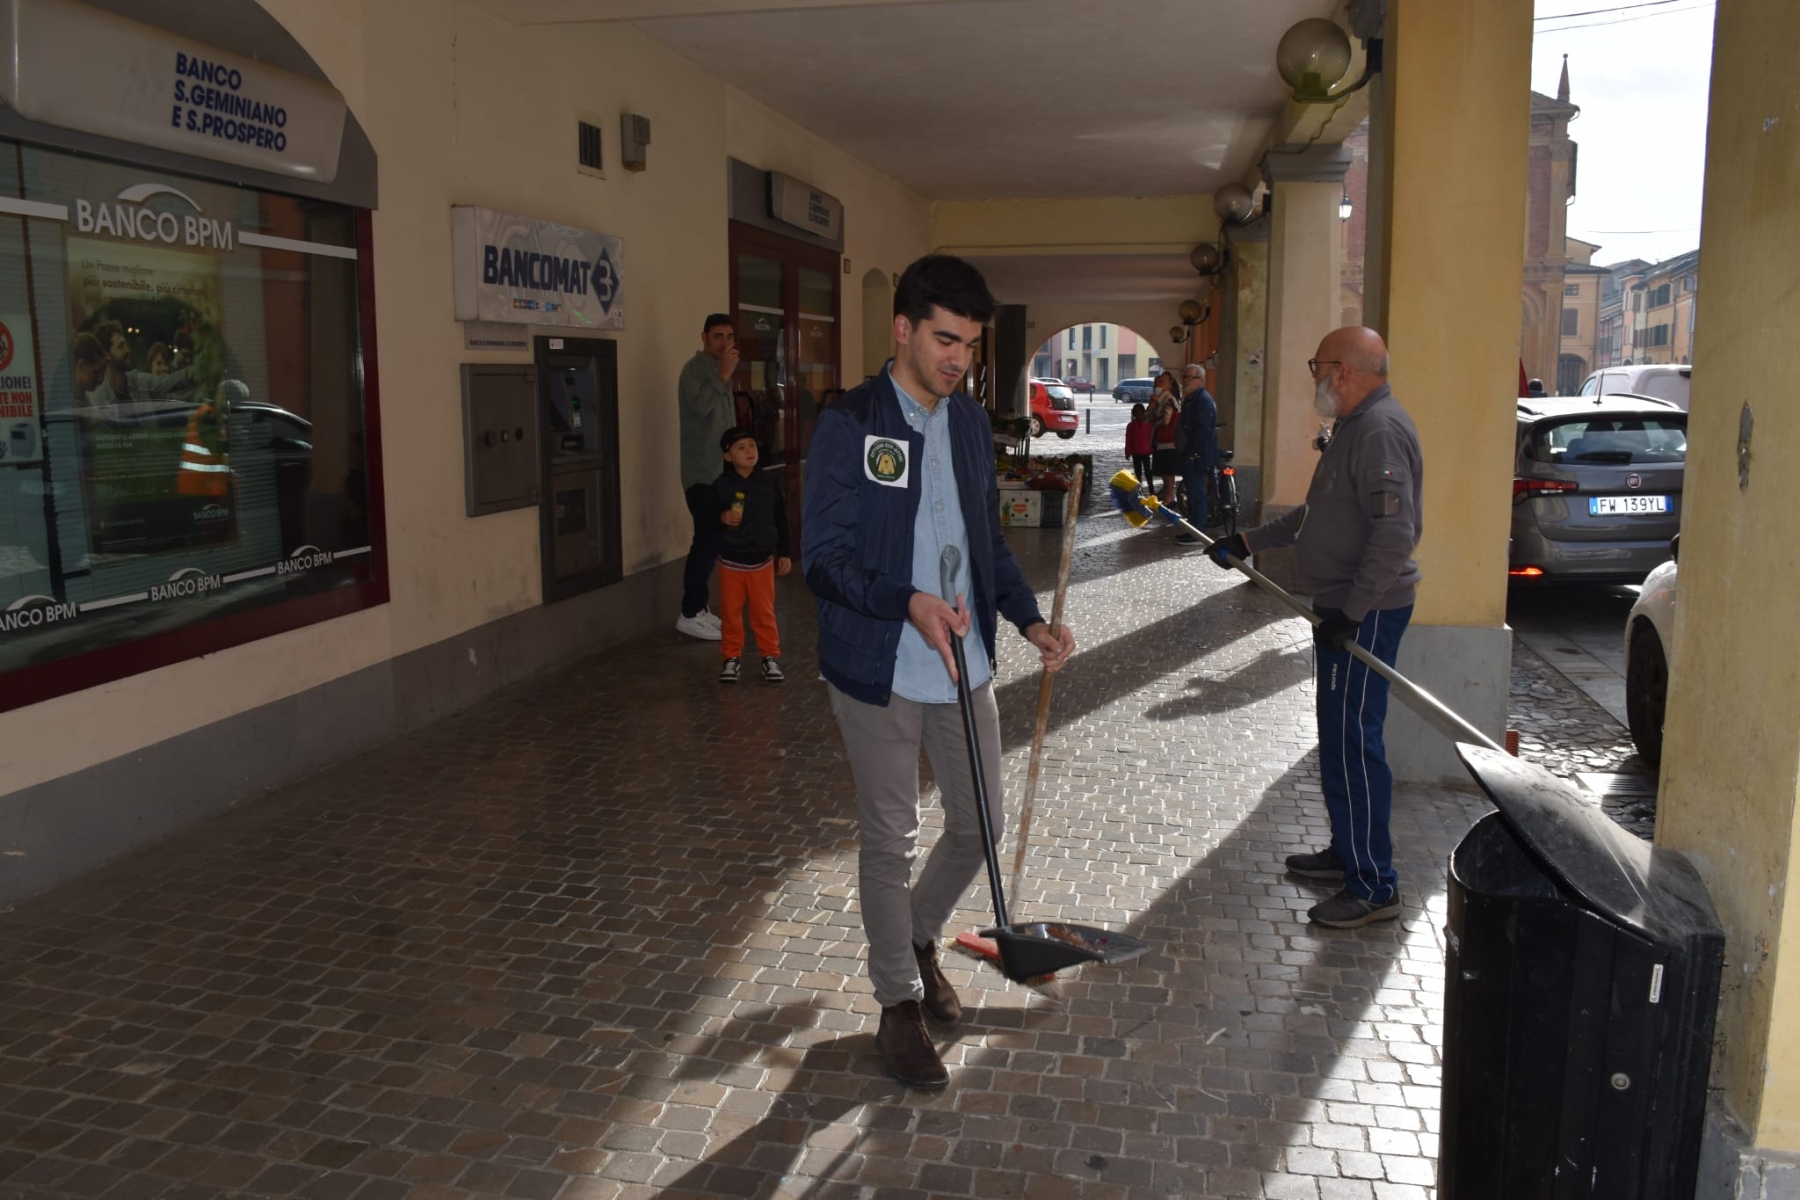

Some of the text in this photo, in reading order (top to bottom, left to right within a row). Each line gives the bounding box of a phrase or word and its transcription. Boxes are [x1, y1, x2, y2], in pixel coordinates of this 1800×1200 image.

[176, 52, 242, 91] BANCO
[174, 79, 287, 128] S.GEMINIANO
[172, 105, 287, 152] E S.PROSPERO
[76, 198, 233, 250] BANCO BPM
[483, 245, 591, 295] BANCOMAT
[83, 275, 99, 289] più
[156, 282, 171, 295] più
[0, 376, 31, 389] IONE!
[11, 391, 33, 404] NON
[193, 508, 216, 520] BANCO
[216, 507, 229, 517] BPM
[1600, 497, 1664, 512] FW 139YL
[277, 551, 332, 575] BANCO BPM
[151, 574, 221, 601] BANCO BPM
[46, 602, 77, 623] BPM
